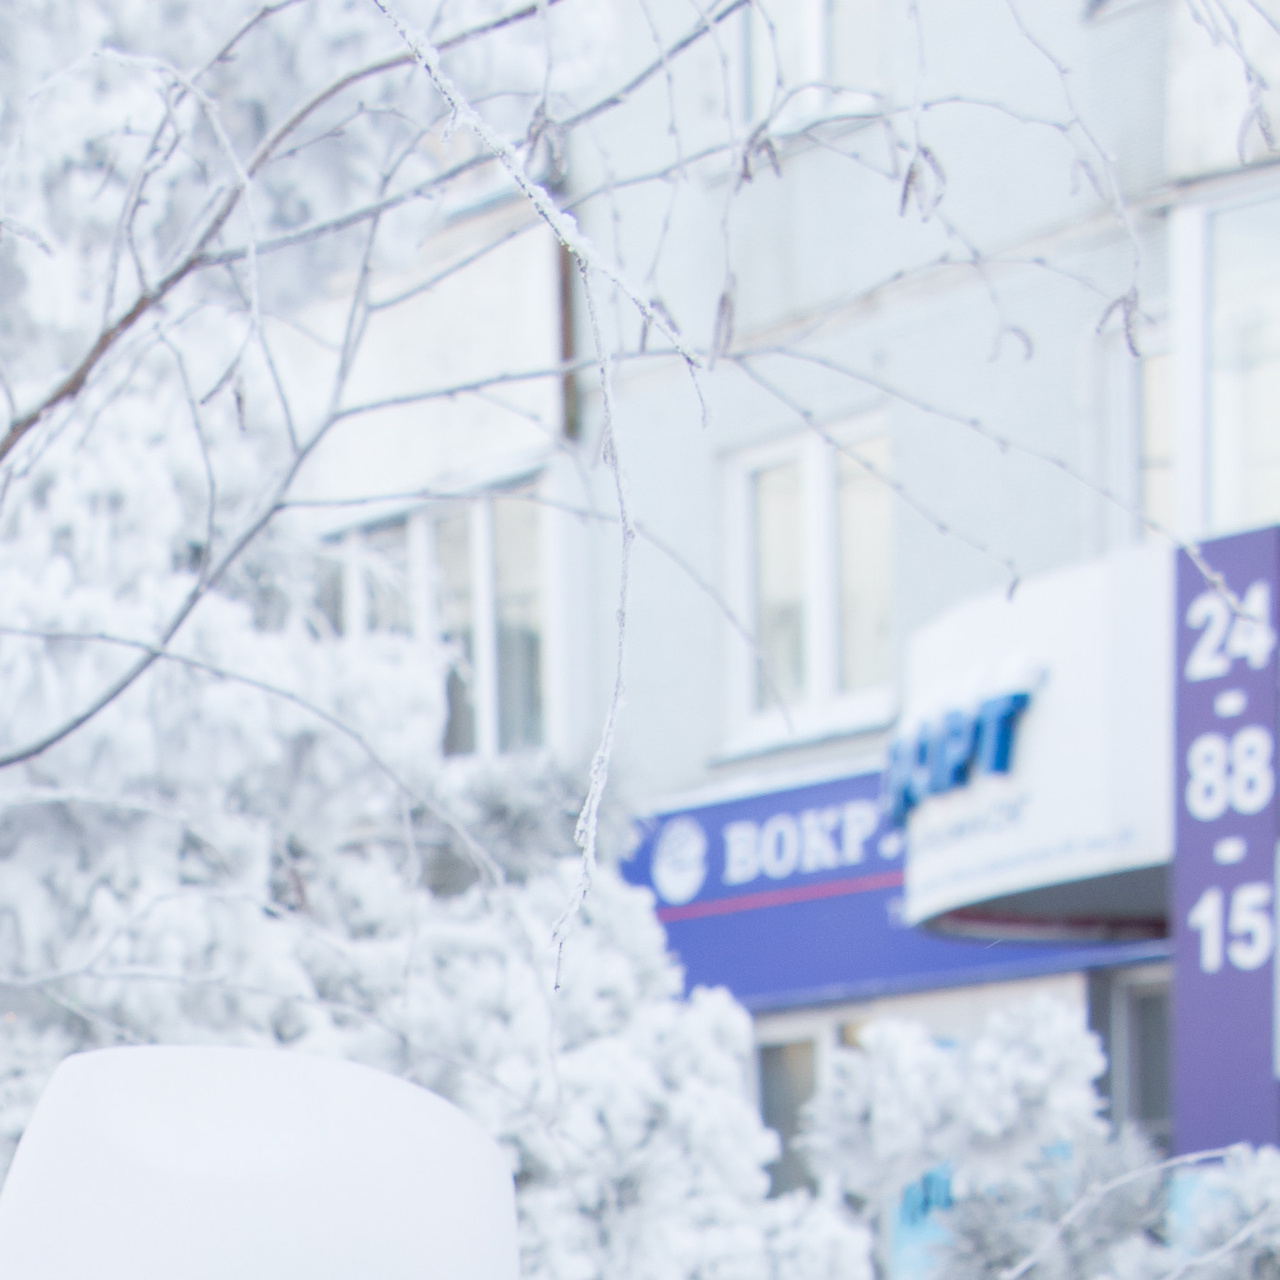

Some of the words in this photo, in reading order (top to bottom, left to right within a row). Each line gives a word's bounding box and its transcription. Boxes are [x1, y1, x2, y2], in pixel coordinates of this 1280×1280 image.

[1184, 578, 1277, 682] 24
[1185, 724, 1275, 822] 88
[1187, 881, 1274, 974] 15
